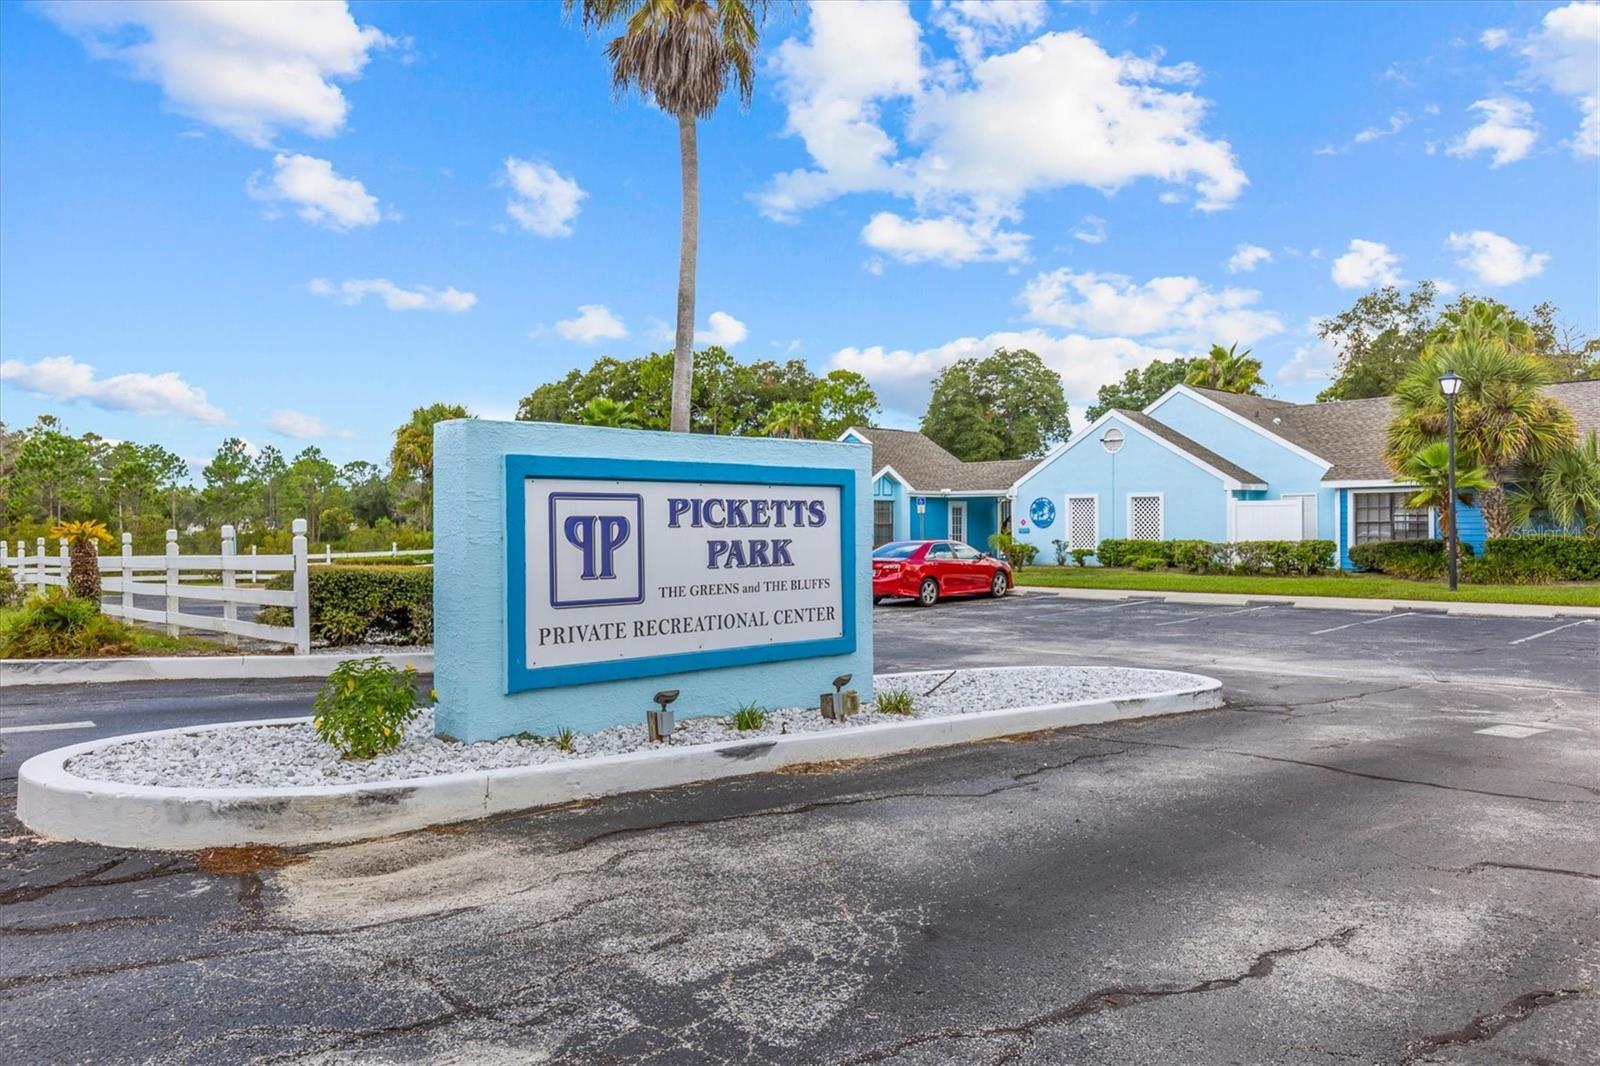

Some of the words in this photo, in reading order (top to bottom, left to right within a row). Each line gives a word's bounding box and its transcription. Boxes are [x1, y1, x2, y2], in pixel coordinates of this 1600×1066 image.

[667, 498, 827, 528] PICKETTS
[706, 539, 795, 569] PARK
[658, 585, 687, 598] THE
[689, 582, 740, 597] GREENS
[742, 581, 760, 594] and
[763, 580, 788, 592] THE
[790, 578, 831, 591] BLUFFS
[538, 621, 627, 646] PRIVATE
[633, 611, 769, 637] RECREATIONAL
[773, 606, 836, 625] CENTER
